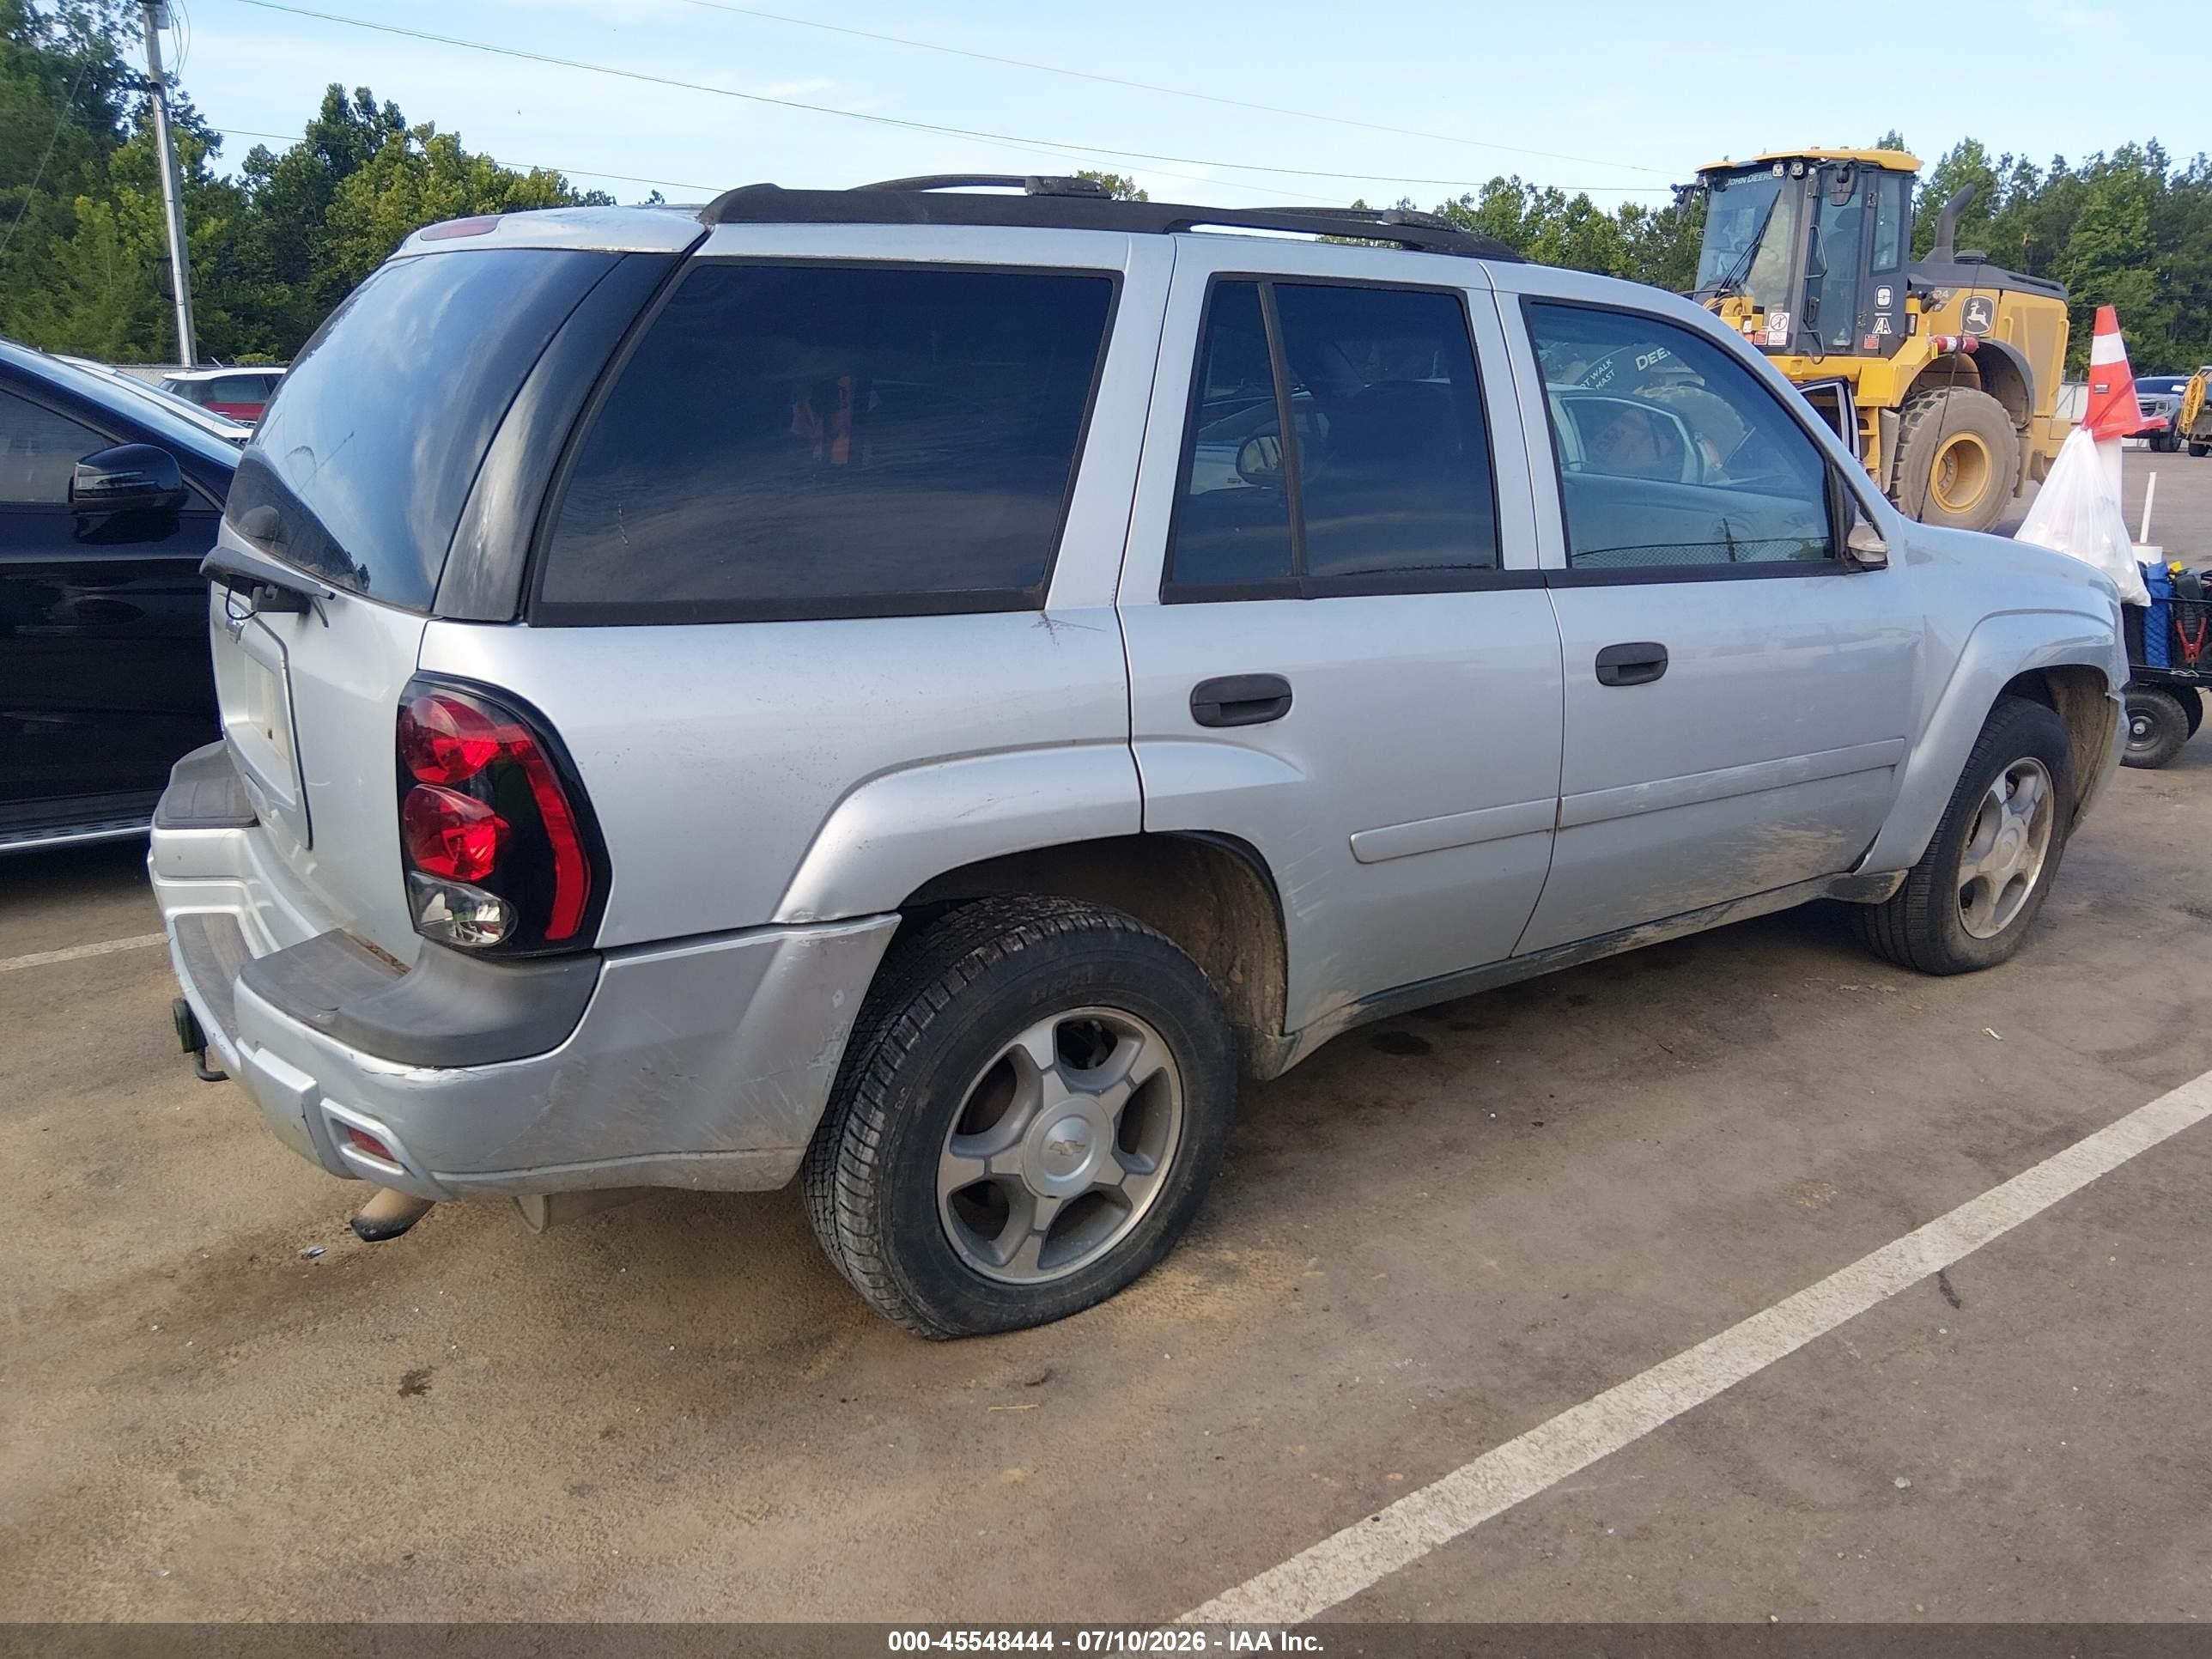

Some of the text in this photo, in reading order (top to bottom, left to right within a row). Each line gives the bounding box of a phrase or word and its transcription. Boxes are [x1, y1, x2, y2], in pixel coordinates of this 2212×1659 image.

[1725, 173, 1773, 187] JOHN DEER
[1589, 359, 1613, 380] WALK
[1635, 347, 1671, 371] DEE
[1595, 369, 1614, 390] MAST
